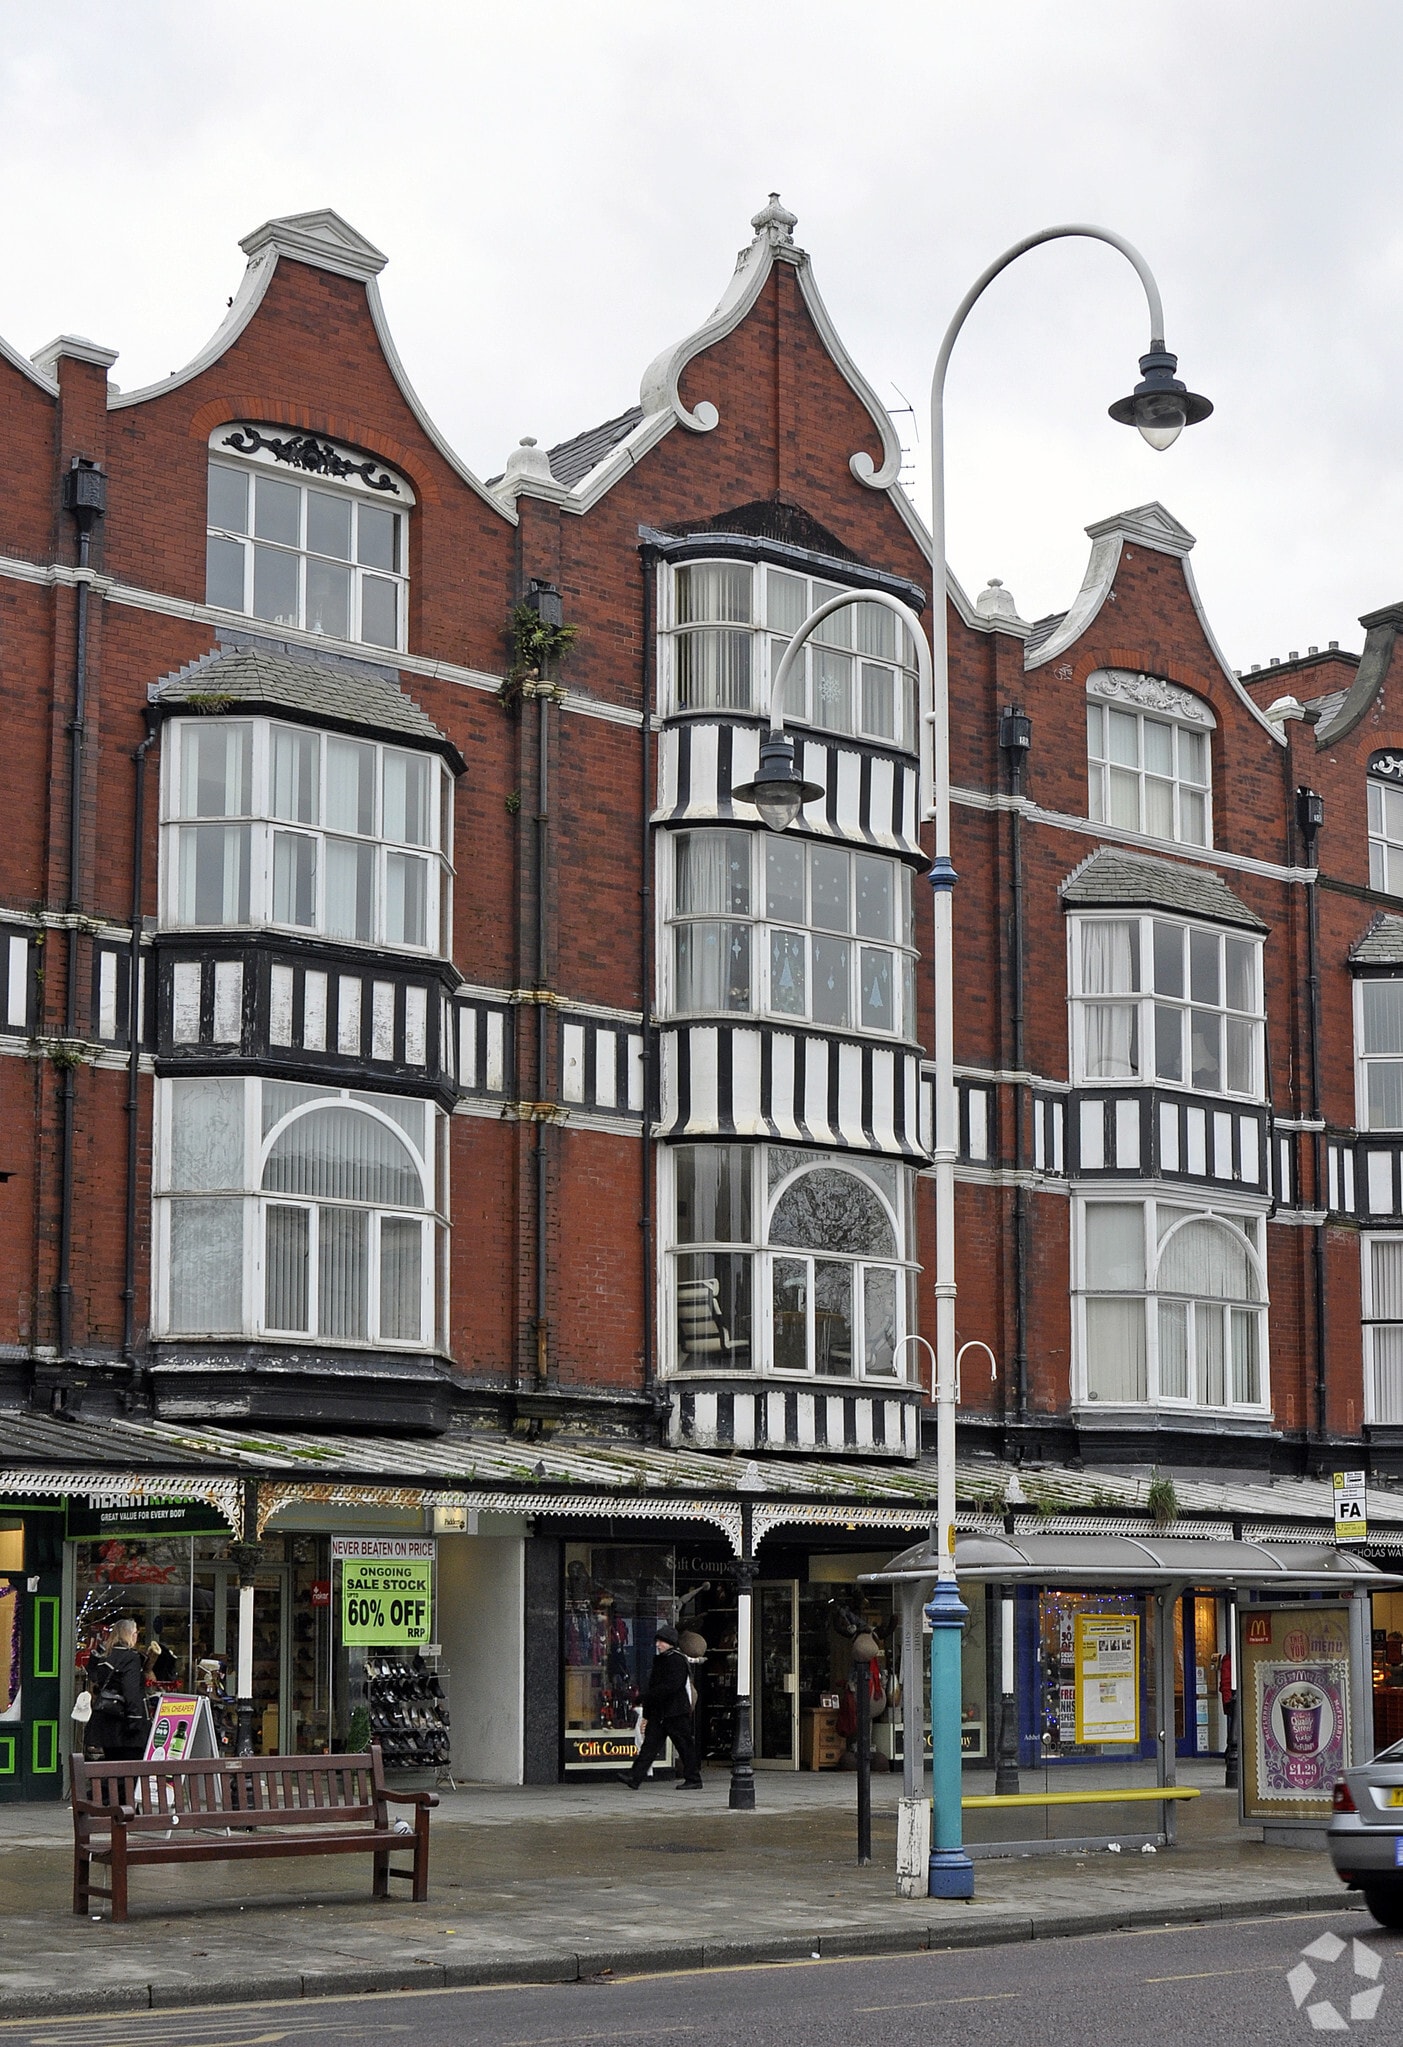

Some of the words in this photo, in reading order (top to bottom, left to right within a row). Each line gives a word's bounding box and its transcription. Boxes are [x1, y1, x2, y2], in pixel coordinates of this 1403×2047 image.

[101, 1512, 118, 1521] GREAT
[120, 1511, 137, 1520] VALUE
[138, 1510, 149, 1519] FOR
[151, 1510, 168, 1519] EVERY
[170, 1509, 185, 1518] BODY
[1340, 1502, 1361, 1518] FA
[333, 1541, 359, 1555] NEVER
[362, 1542, 393, 1555] BEATEN
[395, 1543, 406, 1555] ON
[409, 1543, 433, 1556] PRICE
[1347, 1548, 1386, 1557] CHOLAS
[360, 1567, 412, 1576] ONGOING
[691, 1557, 730, 1574] Compa
[347, 1579, 379, 1589] SALE
[383, 1580, 426, 1590] STOCK
[348, 1599, 384, 1627] 60%
[390, 1600, 425, 1626] OFF
[408, 1628, 425, 1638] RRP
[579, 1741, 601, 1756] Gift
[602, 1741, 638, 1757] Comp
[1289, 1763, 1317, 1776] £1.29
